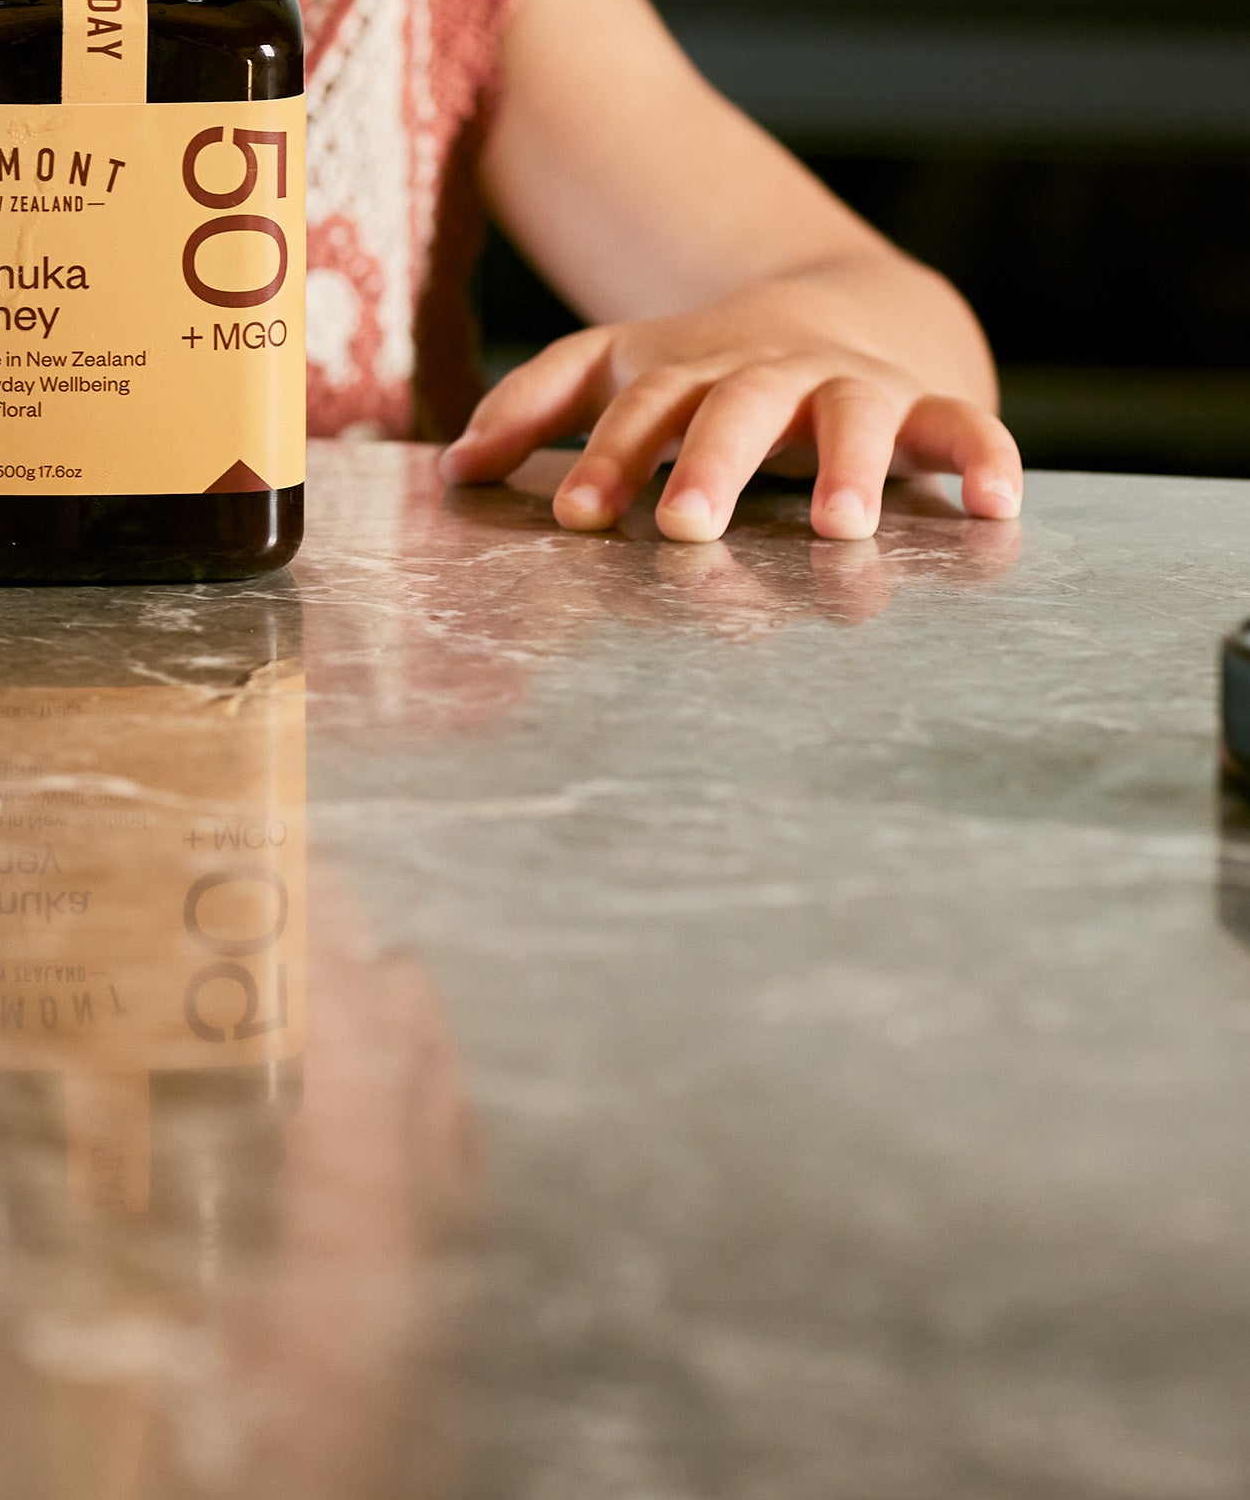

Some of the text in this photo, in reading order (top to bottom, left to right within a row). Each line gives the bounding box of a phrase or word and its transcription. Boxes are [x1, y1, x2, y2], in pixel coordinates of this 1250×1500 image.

[9, 195, 84, 213] ZEALAND
[181, 125, 288, 309] 50
[212, 319, 288, 351] MGO
[6, 350, 22, 368] in
[26, 350, 68, 368] New
[71, 350, 147, 368] Zealand
[39, 375, 131, 397] Wellbeing
[38, 465, 83, 479] 17.6oz
